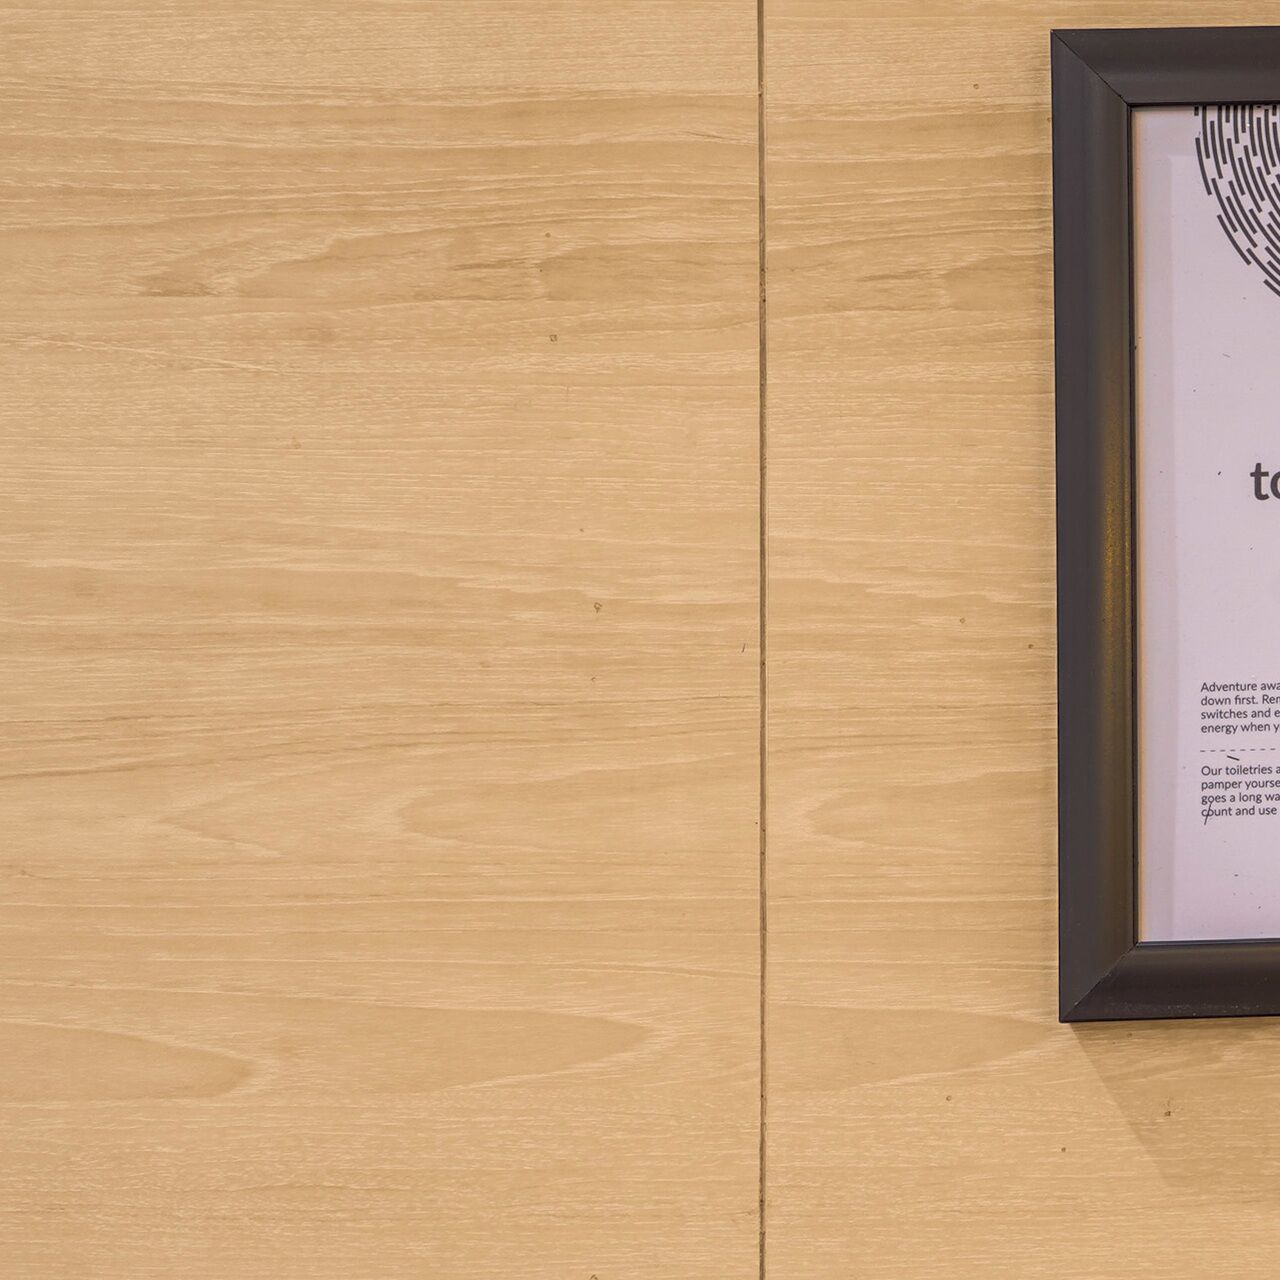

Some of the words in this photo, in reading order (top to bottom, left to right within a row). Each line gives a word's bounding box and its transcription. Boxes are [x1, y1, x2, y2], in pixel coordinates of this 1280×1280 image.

[1200, 682, 1257, 692] Adventure
[1201, 696, 1231, 706] down
[1234, 695, 1258, 705] first.
[1201, 709, 1248, 720] switches
[1251, 708, 1271, 718] and
[1201, 725, 1238, 735] energy
[1240, 722, 1270, 732] when
[1201, 766, 1222, 776] Our
[1225, 764, 1272, 775] toiletries
[1201, 781, 1242, 792] pamper
[1201, 795, 1226, 803] goes
[1239, 792, 1262, 804] long
[1201, 807, 1232, 816] count
[1235, 806, 1255, 816] and
[1258, 807, 1277, 815] use
